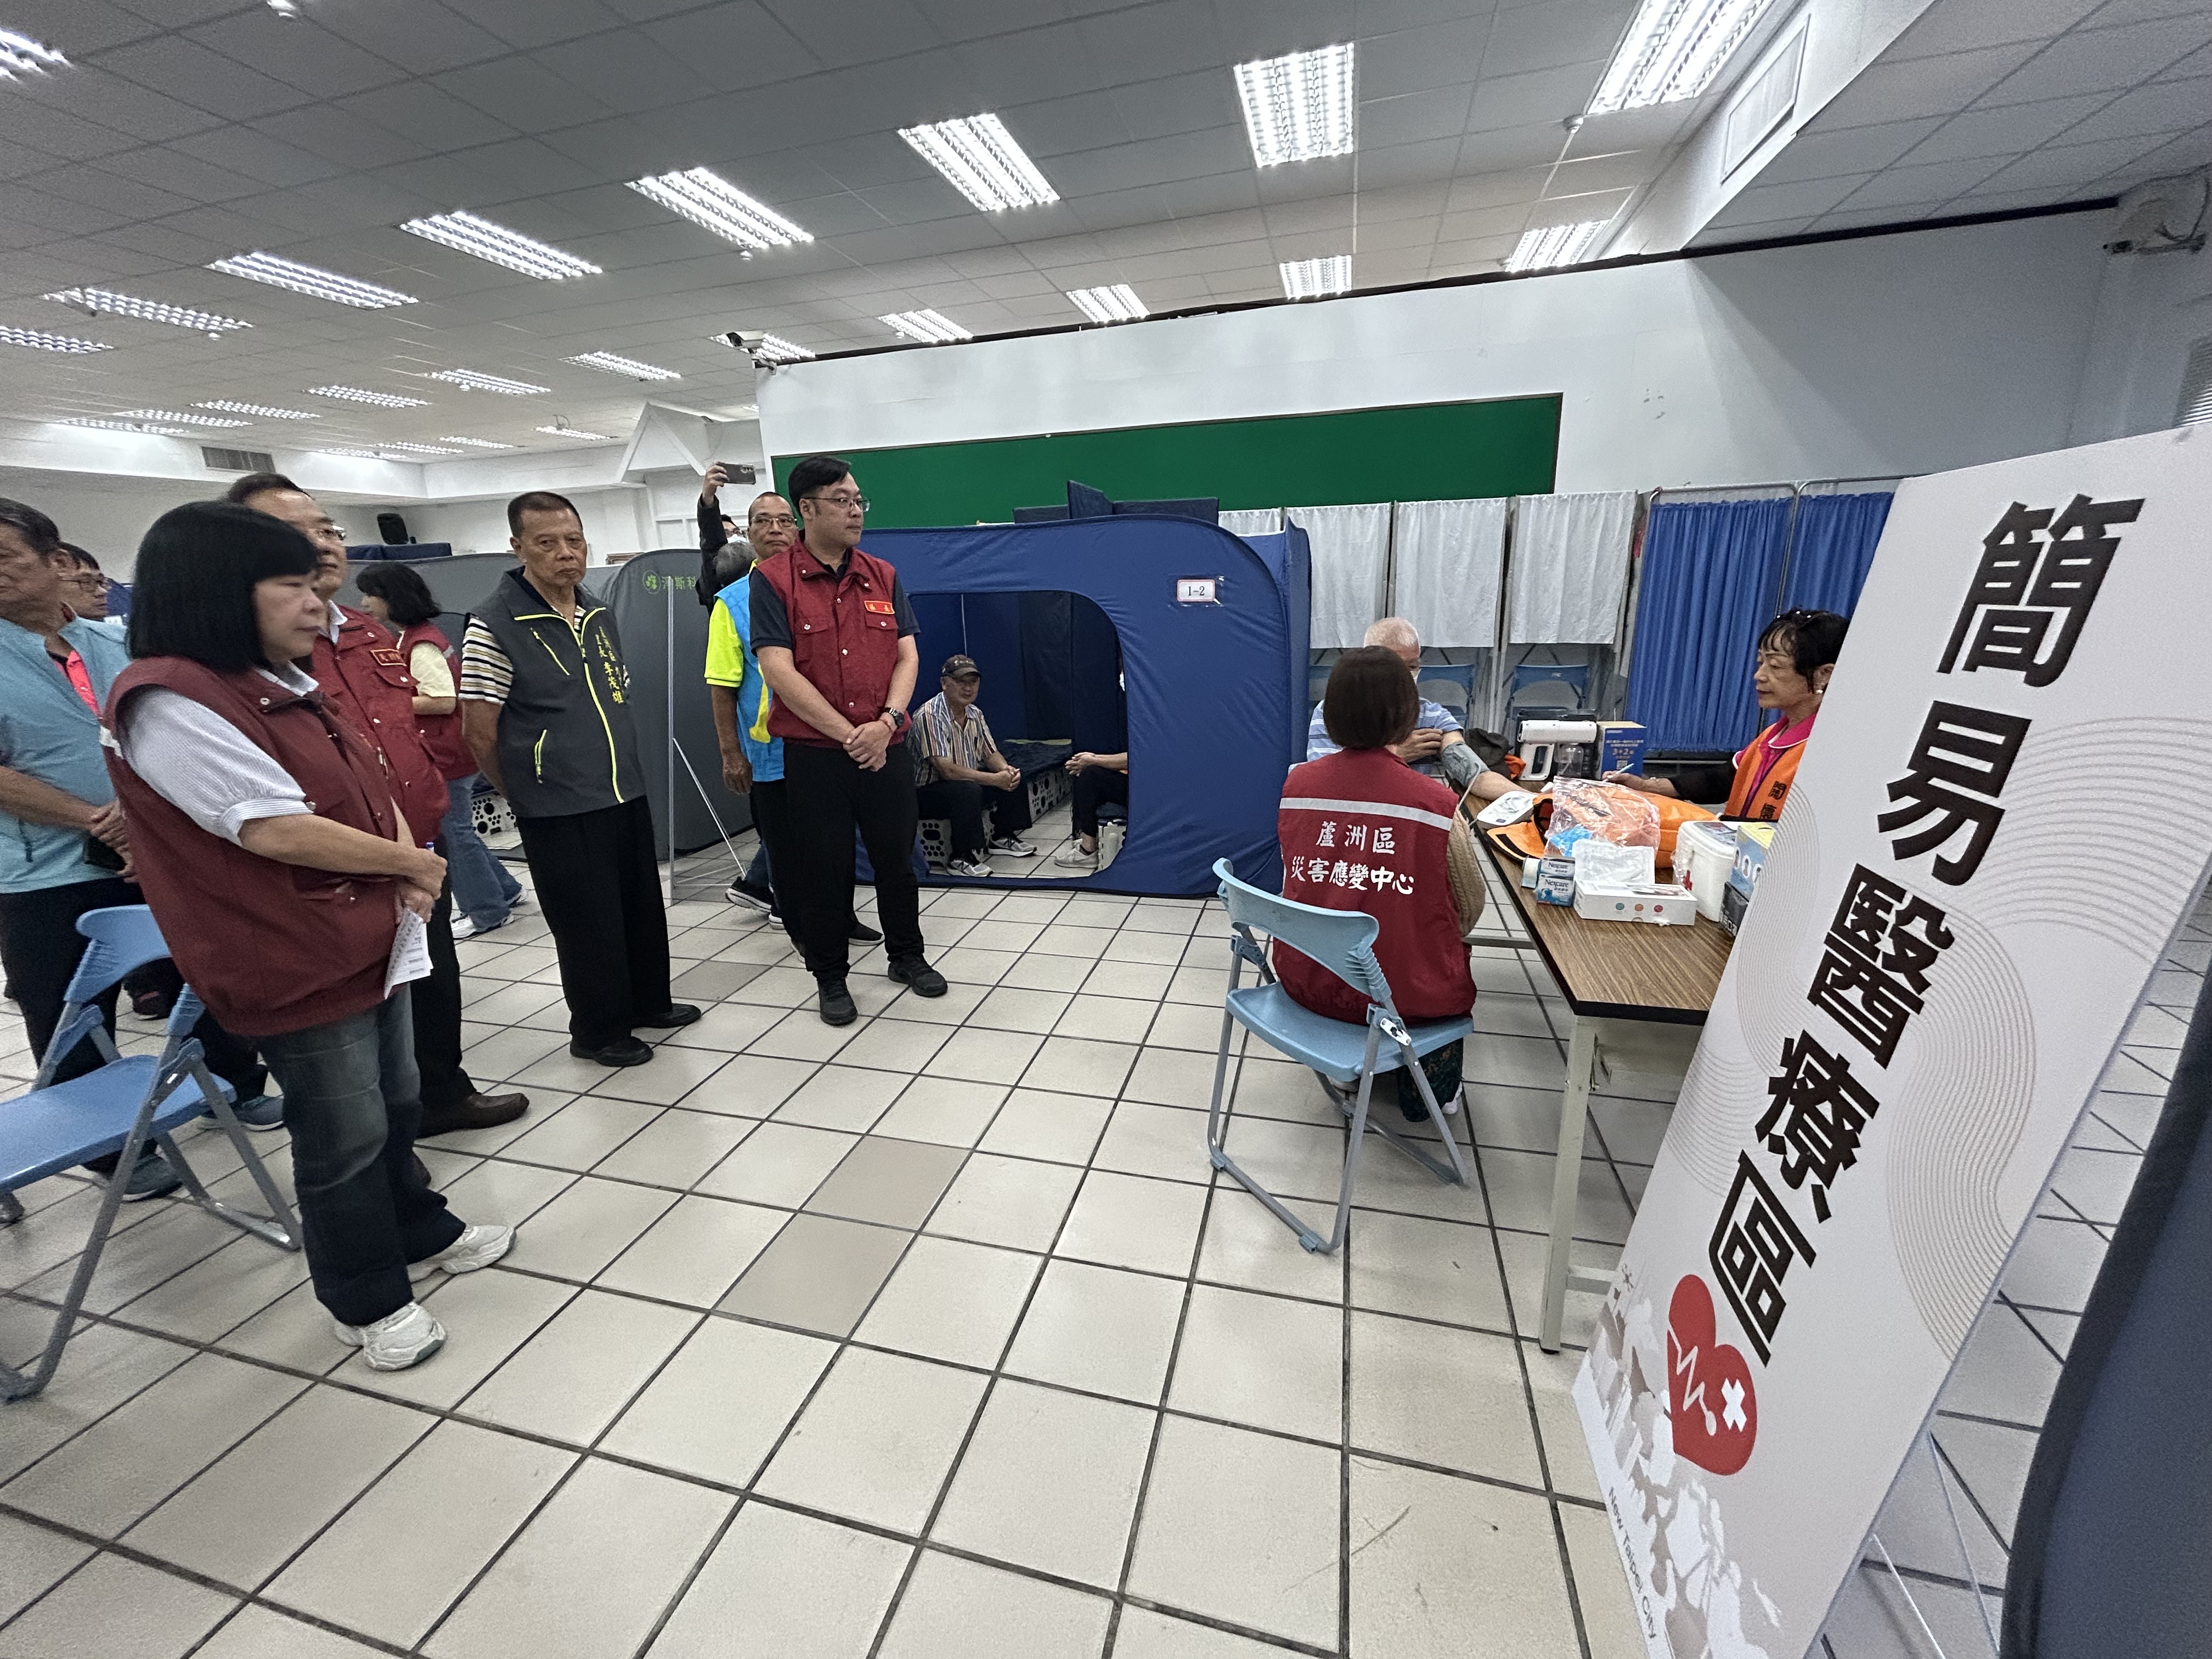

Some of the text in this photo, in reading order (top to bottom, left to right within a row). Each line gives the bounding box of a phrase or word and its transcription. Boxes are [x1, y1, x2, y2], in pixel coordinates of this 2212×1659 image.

[1188, 585, 1205, 596] 1-2
[1315, 821, 1395, 855] 蘆洲區
[1290, 856, 1414, 895] 災害應變中心
[1707, 492, 2147, 1368] 簡易醫療區
[1608, 1486, 1624, 1530] New
[1622, 1529, 1643, 1594] Taipei
